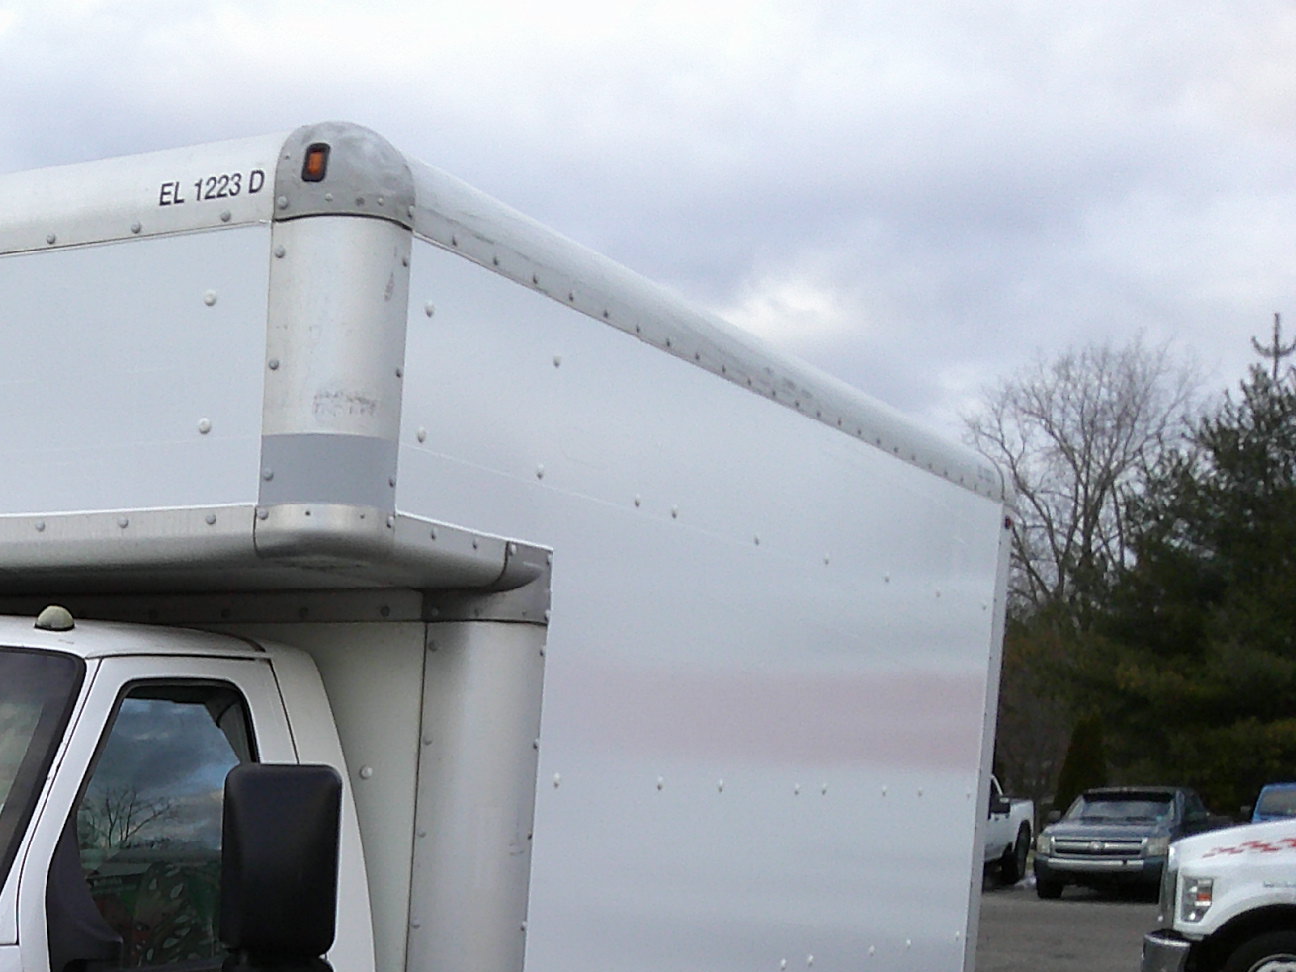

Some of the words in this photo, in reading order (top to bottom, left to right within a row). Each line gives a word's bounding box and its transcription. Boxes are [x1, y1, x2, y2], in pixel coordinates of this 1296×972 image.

[159, 182, 185, 206] EL
[194, 172, 242, 201] 1223
[248, 169, 265, 194] D
